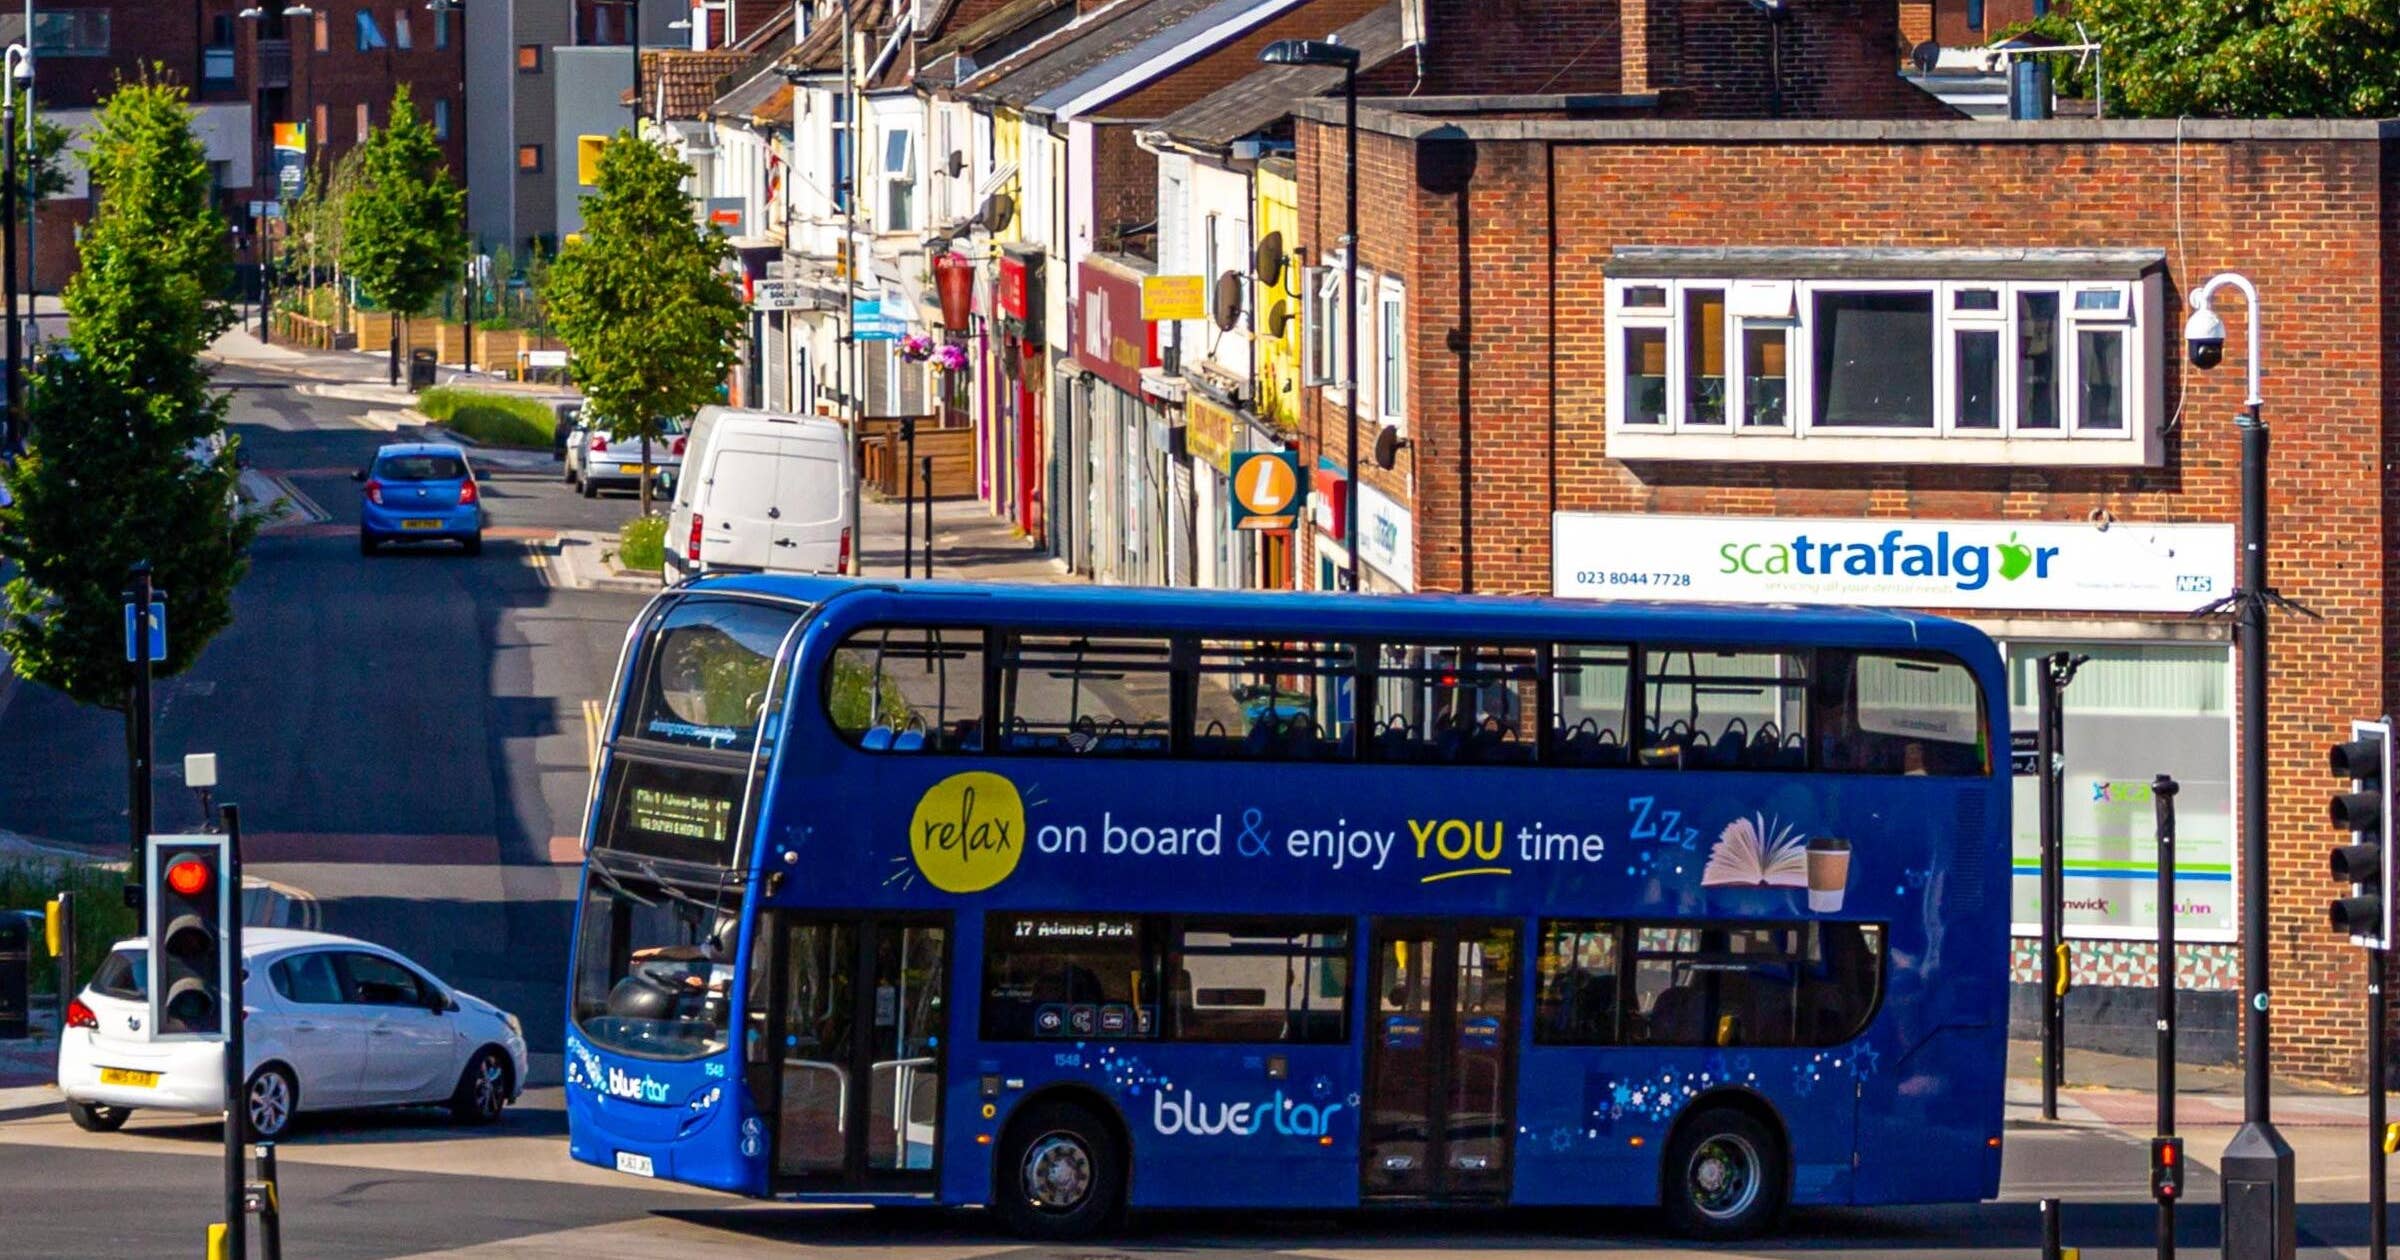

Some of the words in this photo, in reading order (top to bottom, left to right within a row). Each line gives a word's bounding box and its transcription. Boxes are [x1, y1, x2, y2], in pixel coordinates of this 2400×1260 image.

[774, 299, 794, 307] CLUB
[1253, 460, 1280, 505] L
[1576, 570, 1605, 584] 023
[1609, 572, 1648, 585] 8044
[1652, 573, 1691, 586] 7728
[2176, 575, 2211, 592] NHS
[924, 786, 1010, 863] relax
[1037, 825, 1087, 853] on
[1103, 811, 1222, 856] board
[1237, 807, 1271, 857] &
[1286, 818, 1396, 870] enjoy
[1407, 820, 1504, 861] YOU
[1516, 821, 1605, 862] time
[1015, 920, 1034, 936] 17
[1038, 921, 1095, 936] Adanac
[1098, 921, 1134, 937] Park
[1054, 1052, 1081, 1068] 1548
[609, 1066, 670, 1102] bluestar
[1154, 1088, 1343, 1136] bluestar
